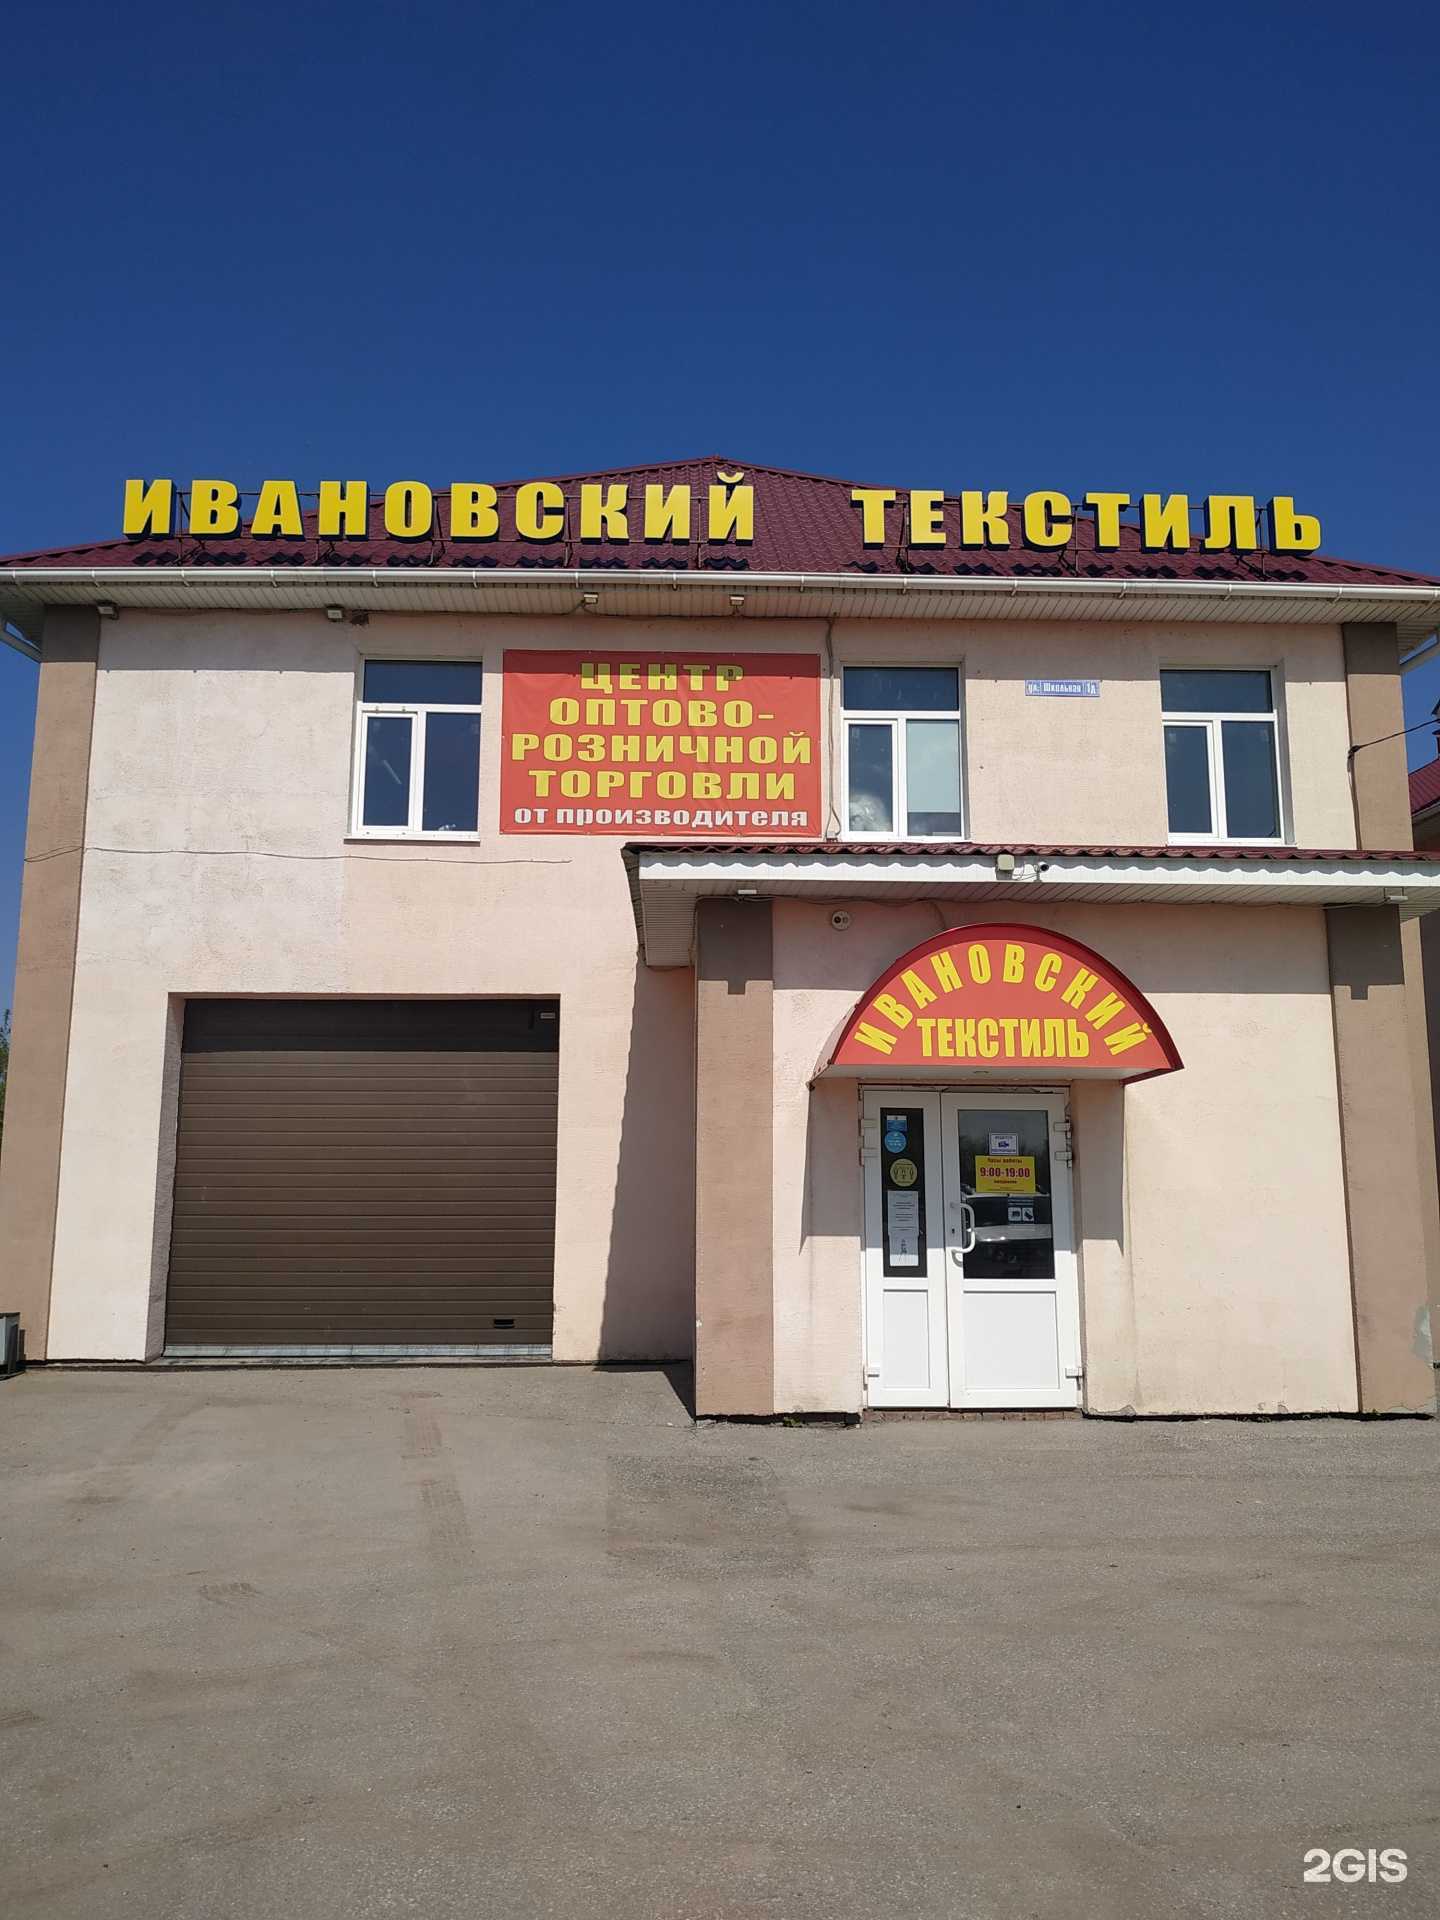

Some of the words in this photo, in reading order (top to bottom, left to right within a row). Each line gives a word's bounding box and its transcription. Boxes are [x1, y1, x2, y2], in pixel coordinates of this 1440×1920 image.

[123, 471, 755, 542] ИВАНОВСКИЙ
[850, 489, 1322, 552] ТЕКСТИЛЬ
[579, 662, 745, 694] ЦЕНТР
[1043, 682, 1081, 693] Школьная
[549, 698, 775, 728] ОПТОВО-
[511, 730, 811, 764] РОЗНИЧНОЙ
[528, 769, 796, 800] ТОРГОВЛИ
[514, 808, 549, 824] от
[556, 808, 809, 828] производителя
[853, 943, 1154, 1057] ИВАНОВСКИЙ
[916, 1018, 1091, 1059] ТЕКСТИЛЬ
